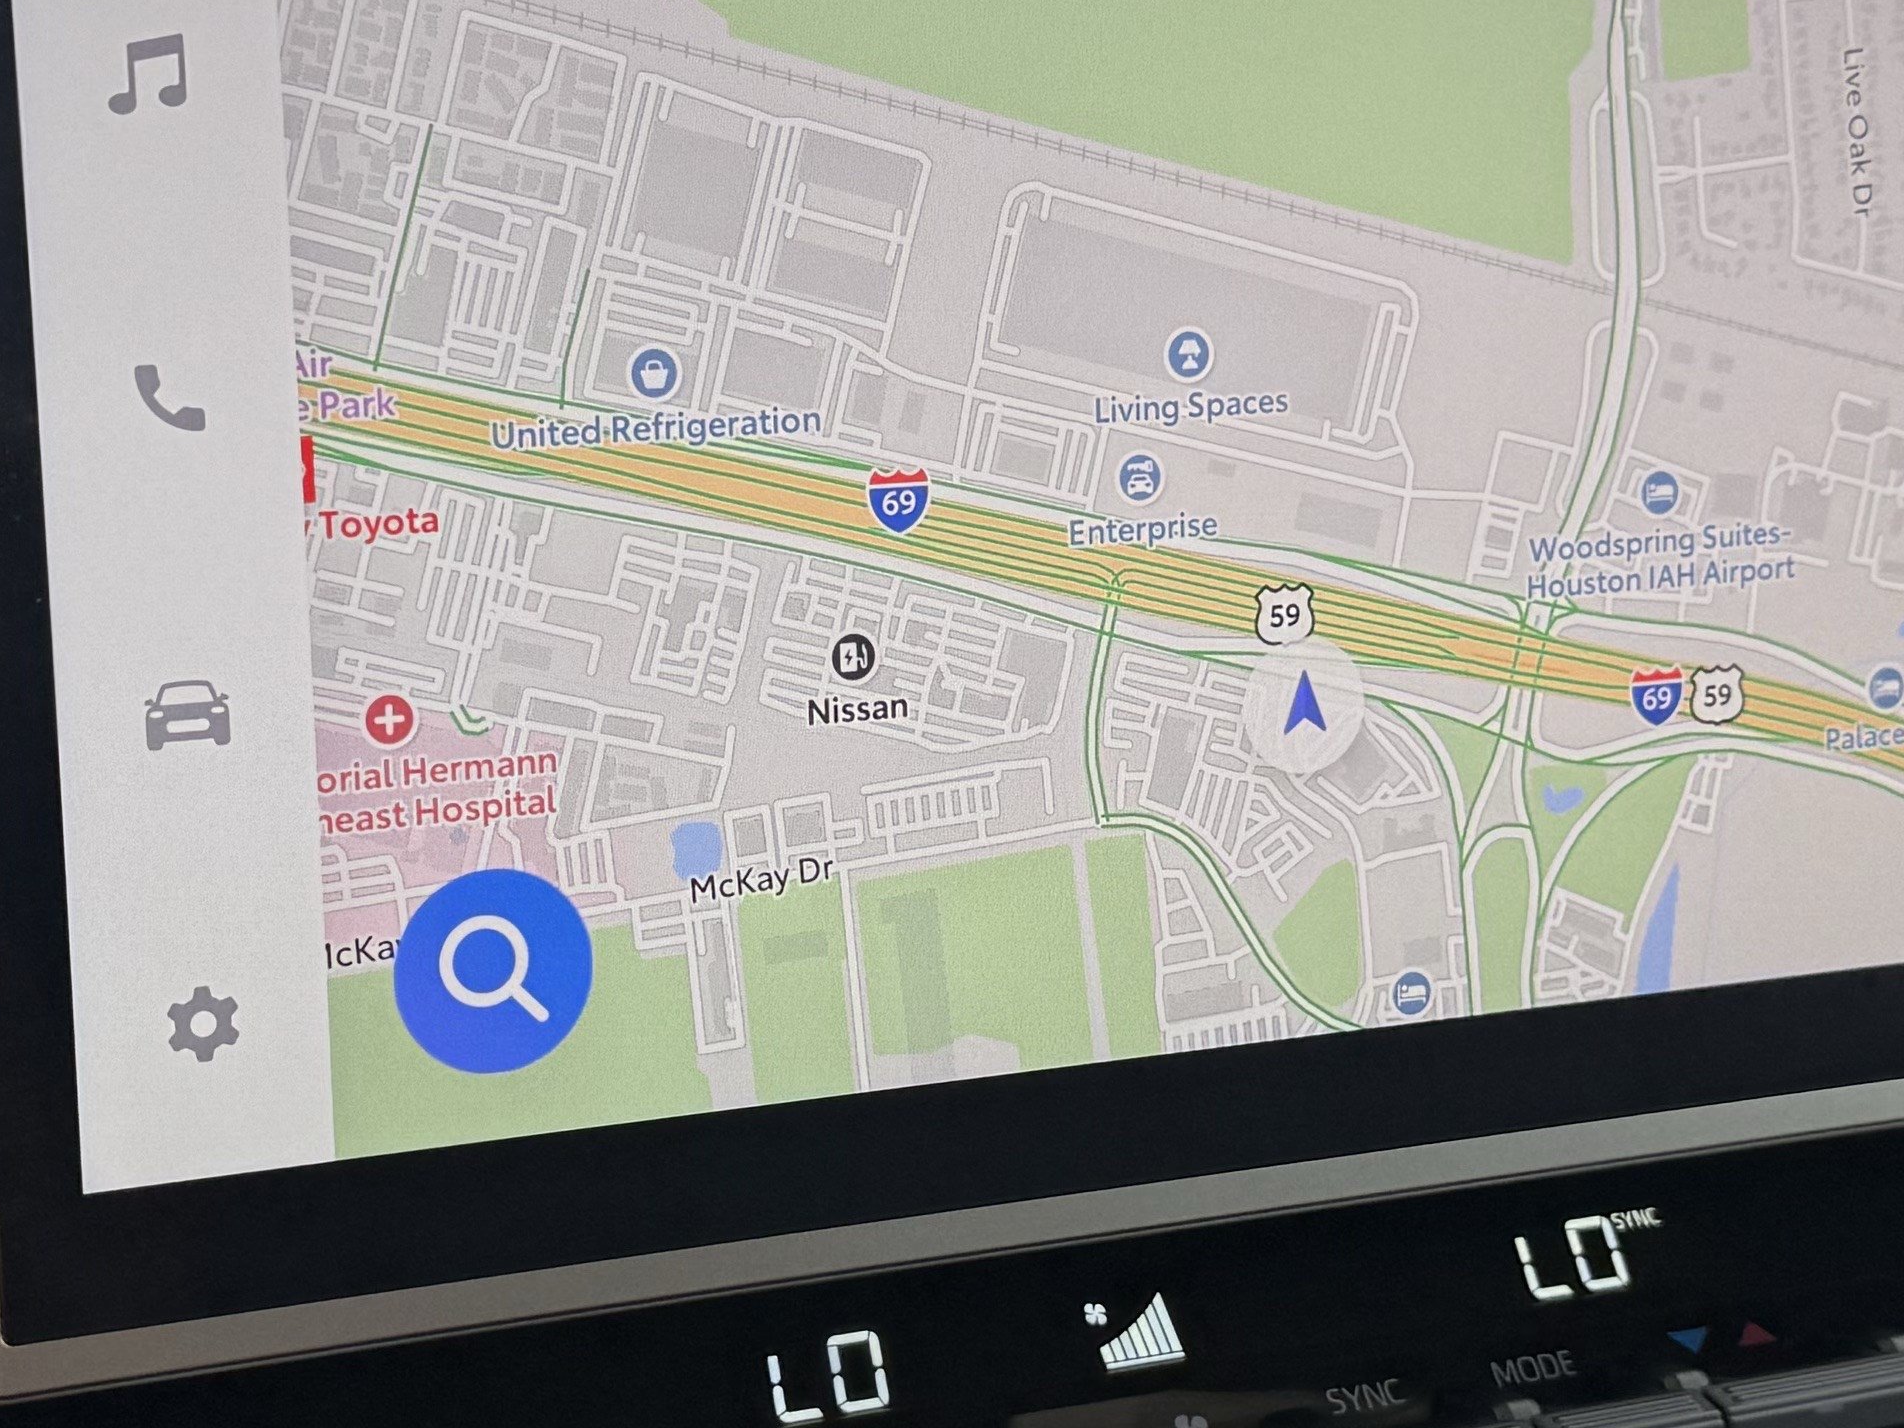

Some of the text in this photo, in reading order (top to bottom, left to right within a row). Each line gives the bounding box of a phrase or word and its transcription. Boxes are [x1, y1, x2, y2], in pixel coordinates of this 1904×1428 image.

[1844, 47, 1873, 219] Live Oak Dr
[320, 387, 395, 420] Park
[1095, 391, 1289, 426] Living Spaces
[491, 408, 822, 449] United Refrigeration
[881, 491, 917, 516] 69
[319, 508, 440, 545] Toyota
[1069, 513, 1219, 547] Enterprise
[1530, 522, 1792, 566] Woodspring Suites-
[1528, 555, 1795, 600] Houston IAH Airport
[1269, 603, 1300, 629] 59
[807, 696, 909, 726] Nissan
[1641, 685, 1673, 711] 69
[1704, 684, 1733, 708] 59
[403, 752, 558, 786] Hermann
[415, 784, 557, 828] Hospital
[690, 857, 835, 904] McKay Dr
[325, 935, 400, 969] cKa
[1514, 1207, 1662, 1301] LO SYNC
[767, 1329, 891, 1424] LO
[1491, 1349, 1575, 1388] MODE
[1326, 1378, 1408, 1416] SYNC
